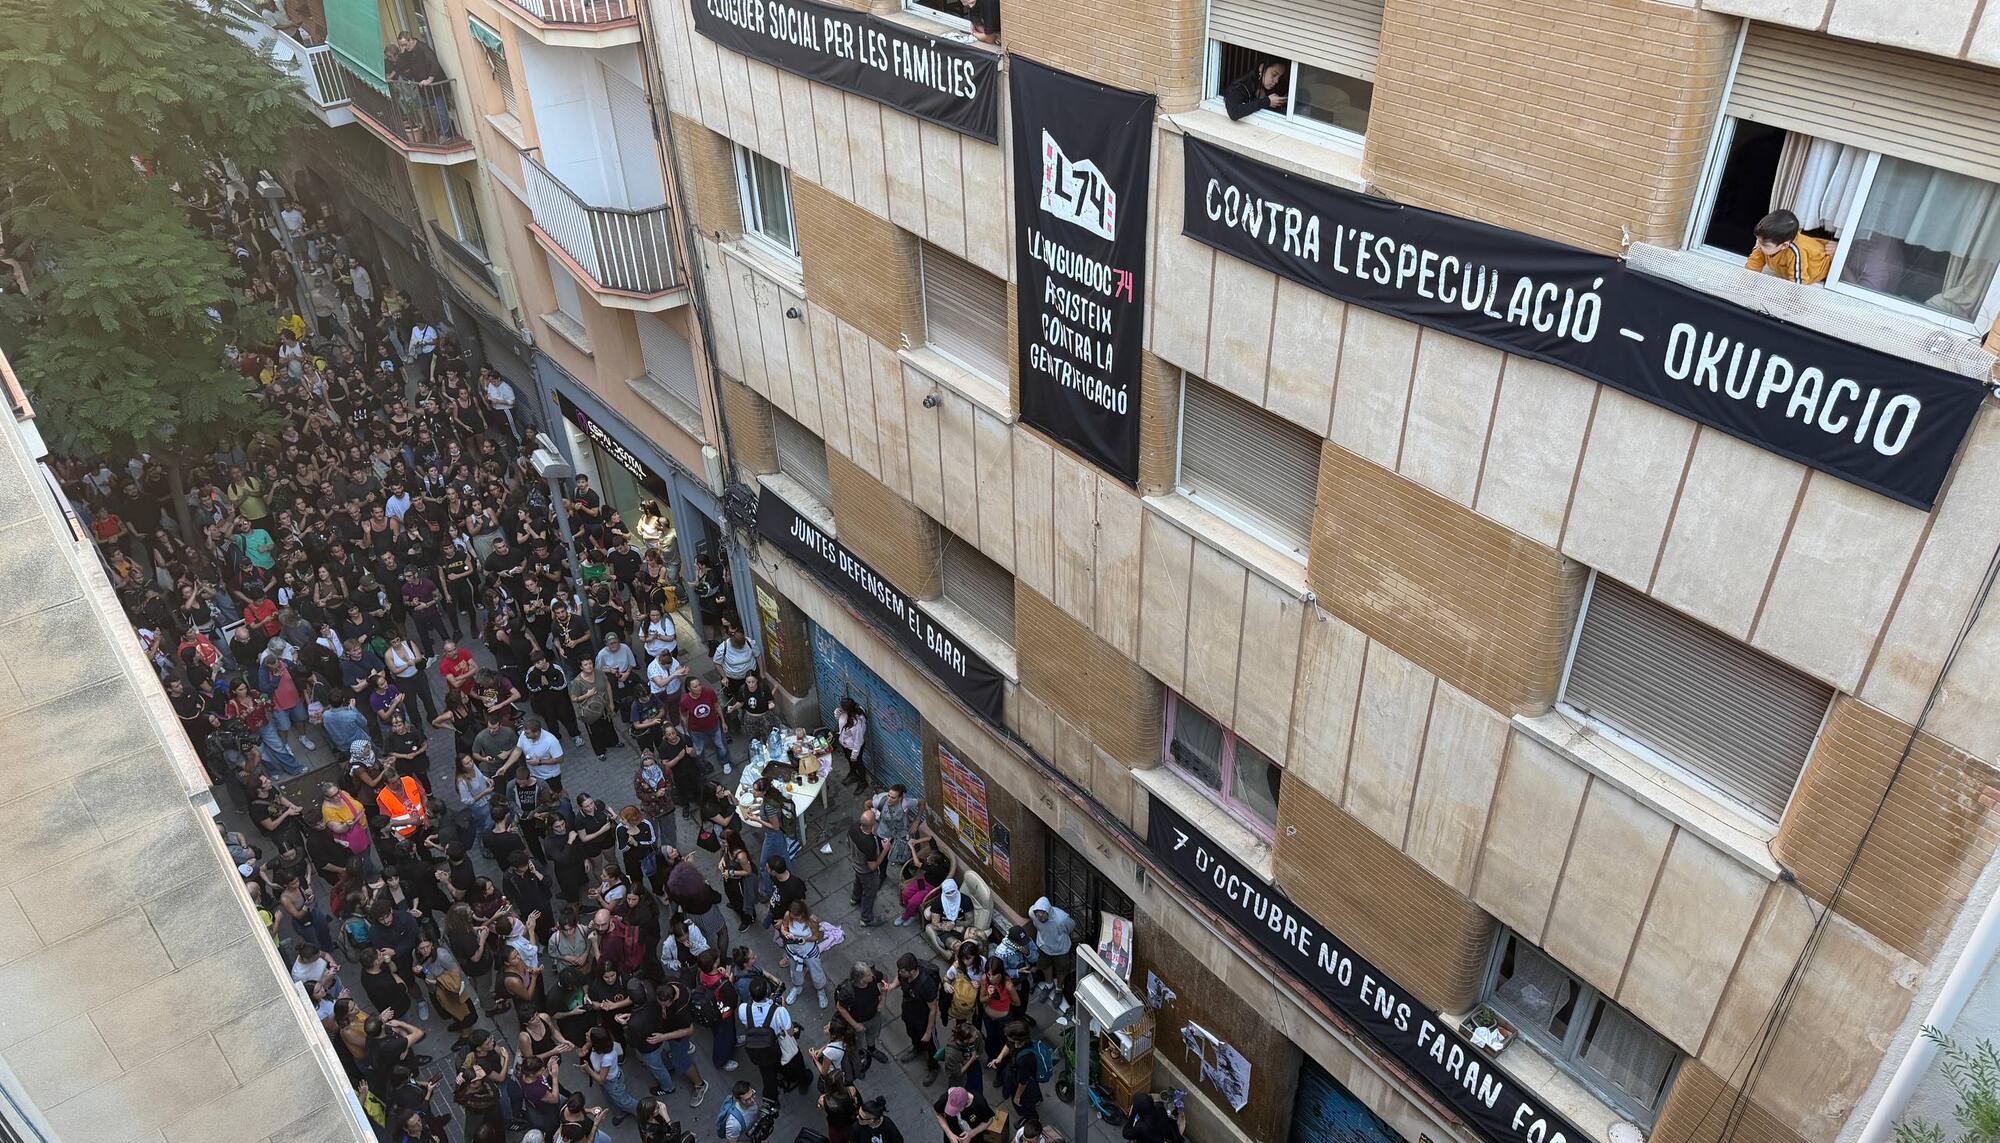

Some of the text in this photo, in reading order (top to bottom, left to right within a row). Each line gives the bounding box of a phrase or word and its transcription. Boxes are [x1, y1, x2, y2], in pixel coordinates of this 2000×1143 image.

[768, 1, 820, 52] SOCIAL
[824, 17, 854, 60] PER
[859, 25, 888, 71] LES
[893, 39, 976, 99] FAMÍLIES
[1055, 152, 1105, 230] L74
[1041, 313, 1113, 374] CONTRA LA
[1206, 178, 1320, 263] CONTRA
[1333, 224, 1604, 343] L'ESPECULACIÓ
[1664, 322, 1922, 456] OKUPACIO
[1030, 343, 1128, 415] GENTRIFICACIÓ
[790, 516, 966, 677] JUNTES DEFENSEM EL BARRI
[1172, 827, 1189, 851] 7
[1195, 846, 1313, 957] D'OCTUBRE
[1317, 942, 1352, 987] NO
[1359, 974, 1412, 1032] ENS
[1417, 1019, 1503, 1109] FARAN
